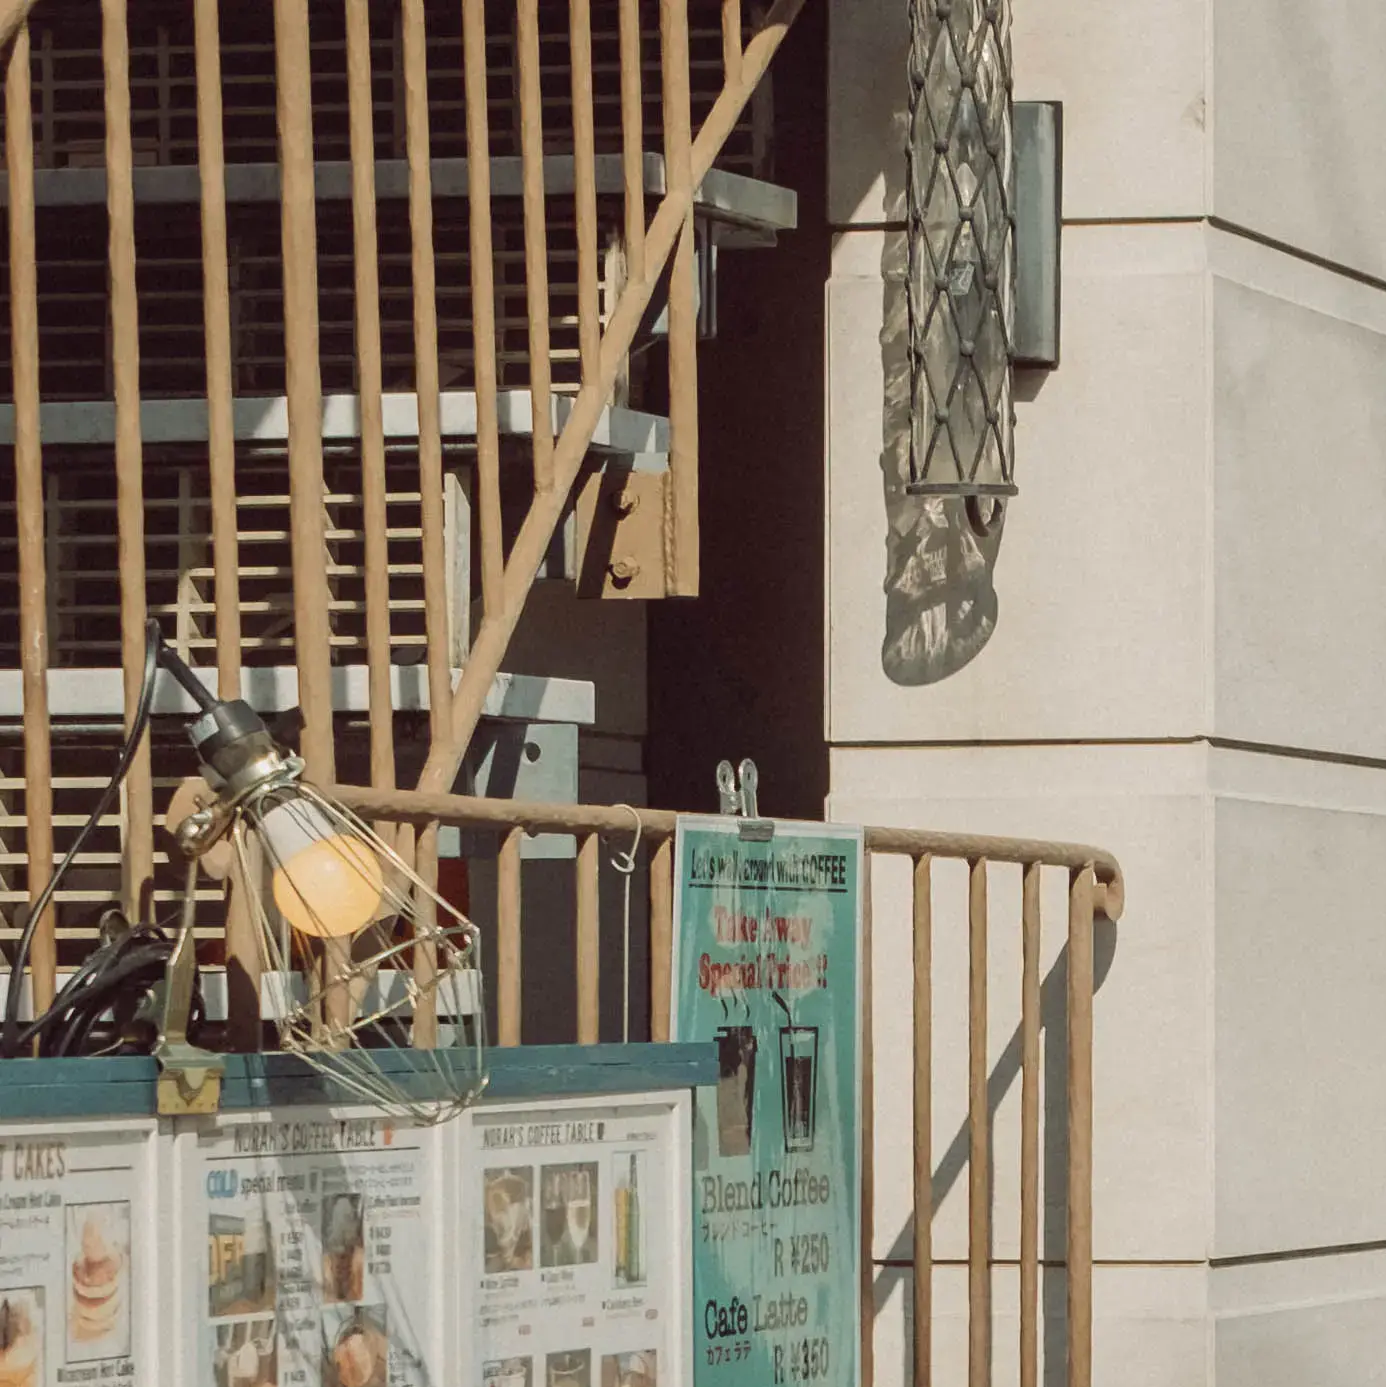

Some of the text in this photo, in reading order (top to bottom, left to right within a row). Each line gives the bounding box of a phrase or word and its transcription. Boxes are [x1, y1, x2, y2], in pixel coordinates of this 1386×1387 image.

[802, 854, 847, 885] COFFEE
[713, 905, 812, 945] Take Away
[699, 952, 761, 997] Special
[767, 953, 811, 989] Price
[337, 1119, 376, 1150] TABLE
[527, 1124, 561, 1145] COFFEE
[564, 1122, 595, 1143] TABLE
[14, 1141, 66, 1181] CAKES
[701, 1167, 831, 1214] Blend Coffee
[774, 1232, 831, 1277] R ¥250
[704, 1296, 748, 1340] Cafe
[752, 1292, 809, 1333] Latte
[773, 1336, 830, 1385] R ¥350
